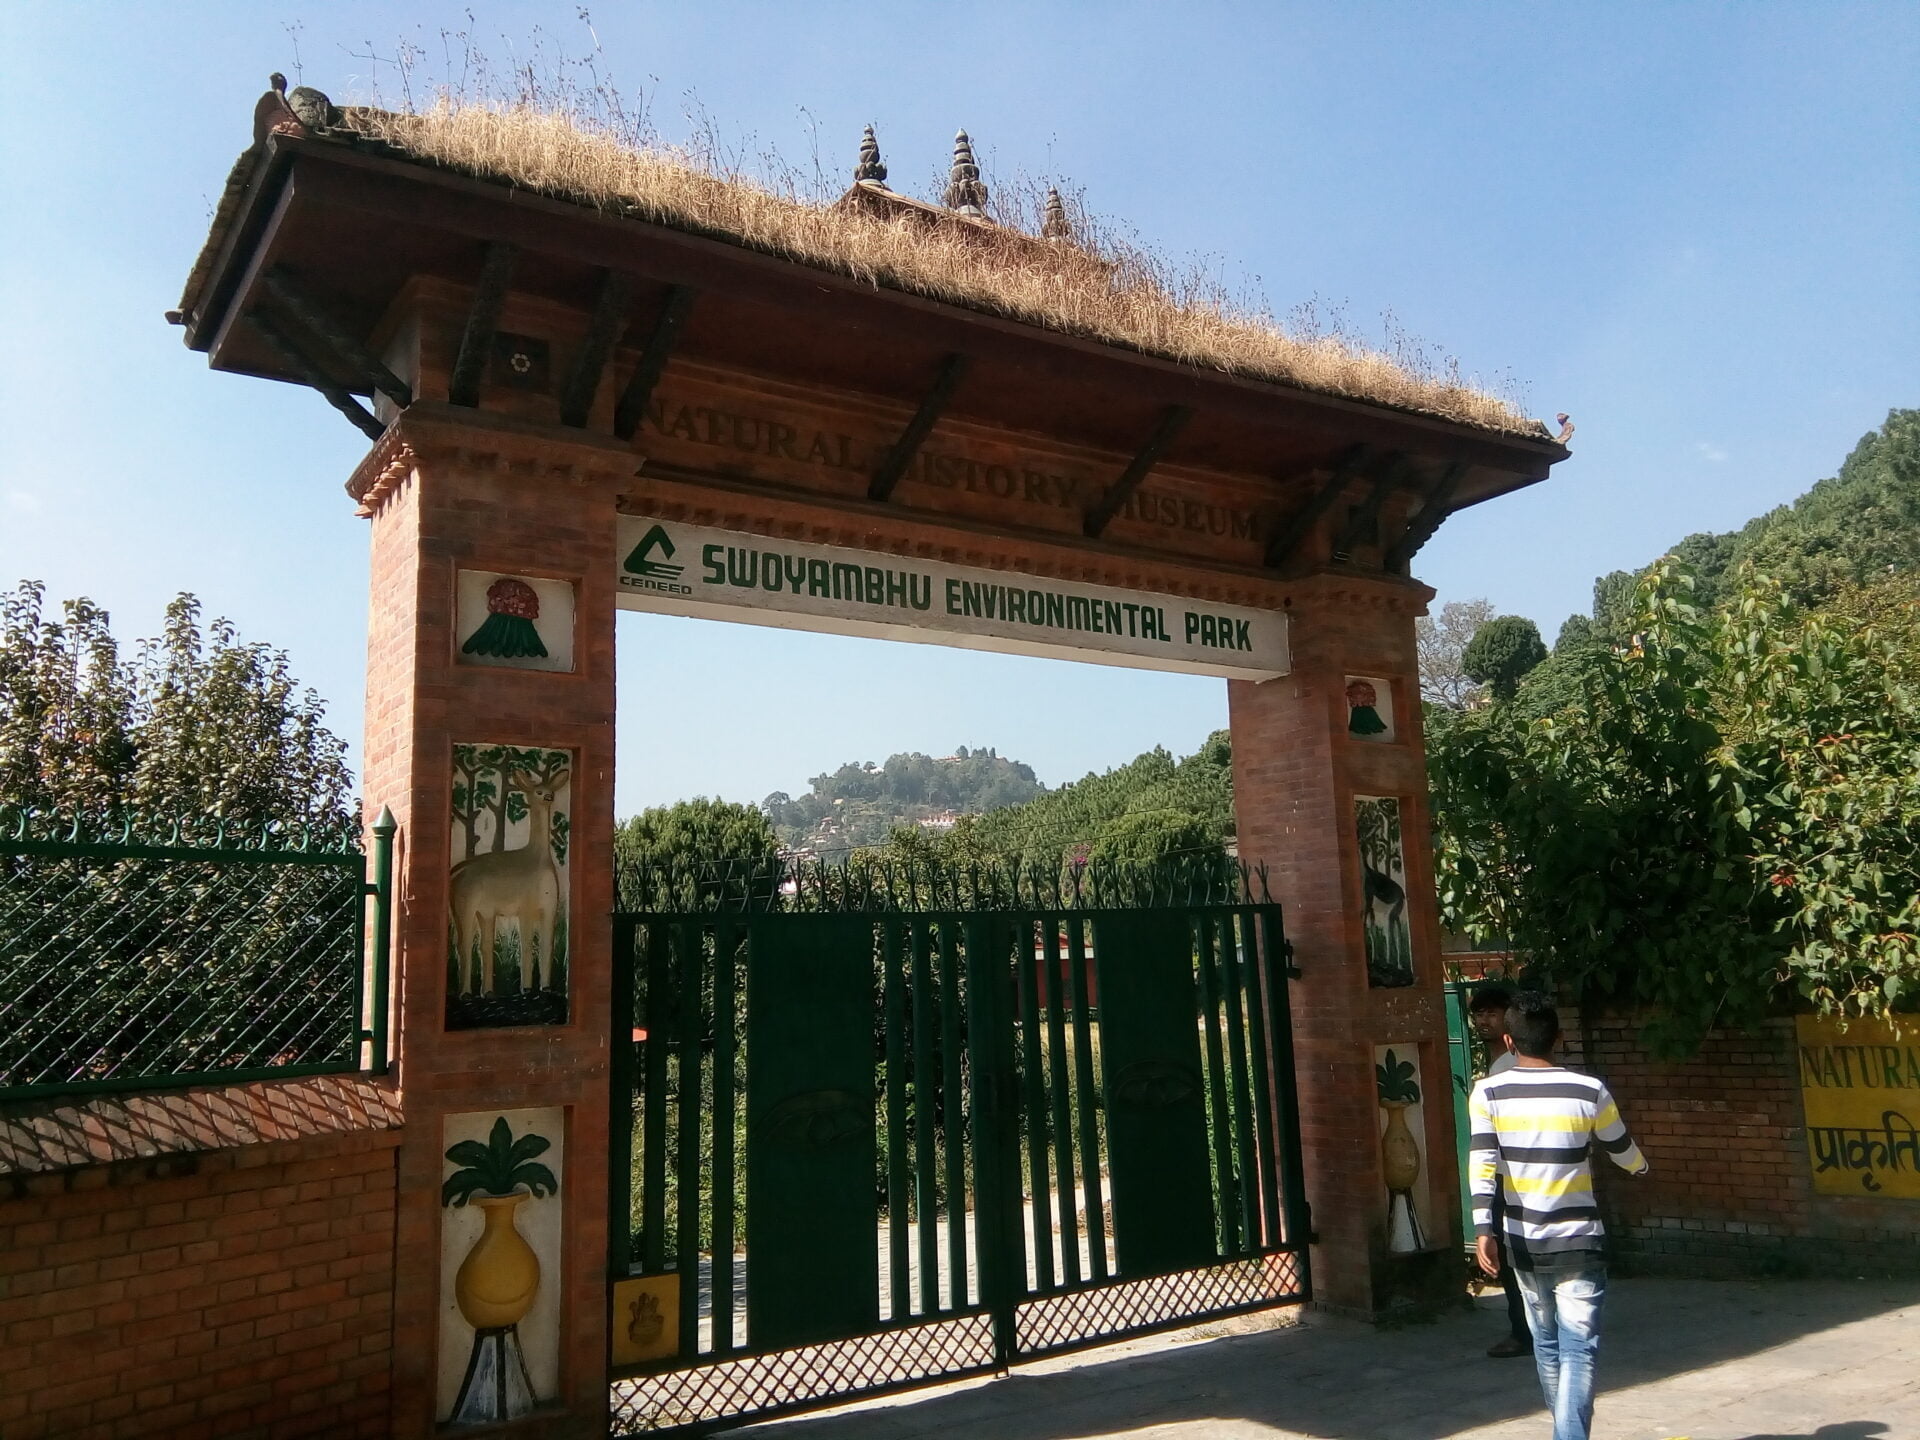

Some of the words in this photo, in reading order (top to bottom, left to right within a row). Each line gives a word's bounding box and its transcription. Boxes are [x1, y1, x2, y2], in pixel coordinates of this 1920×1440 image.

[893, 447, 1081, 508] ISTORY
[702, 544, 931, 611] SWOYAMBHU
[945, 578, 1171, 643] ENVIRONMENTAL
[1184, 611, 1253, 652] PARK
